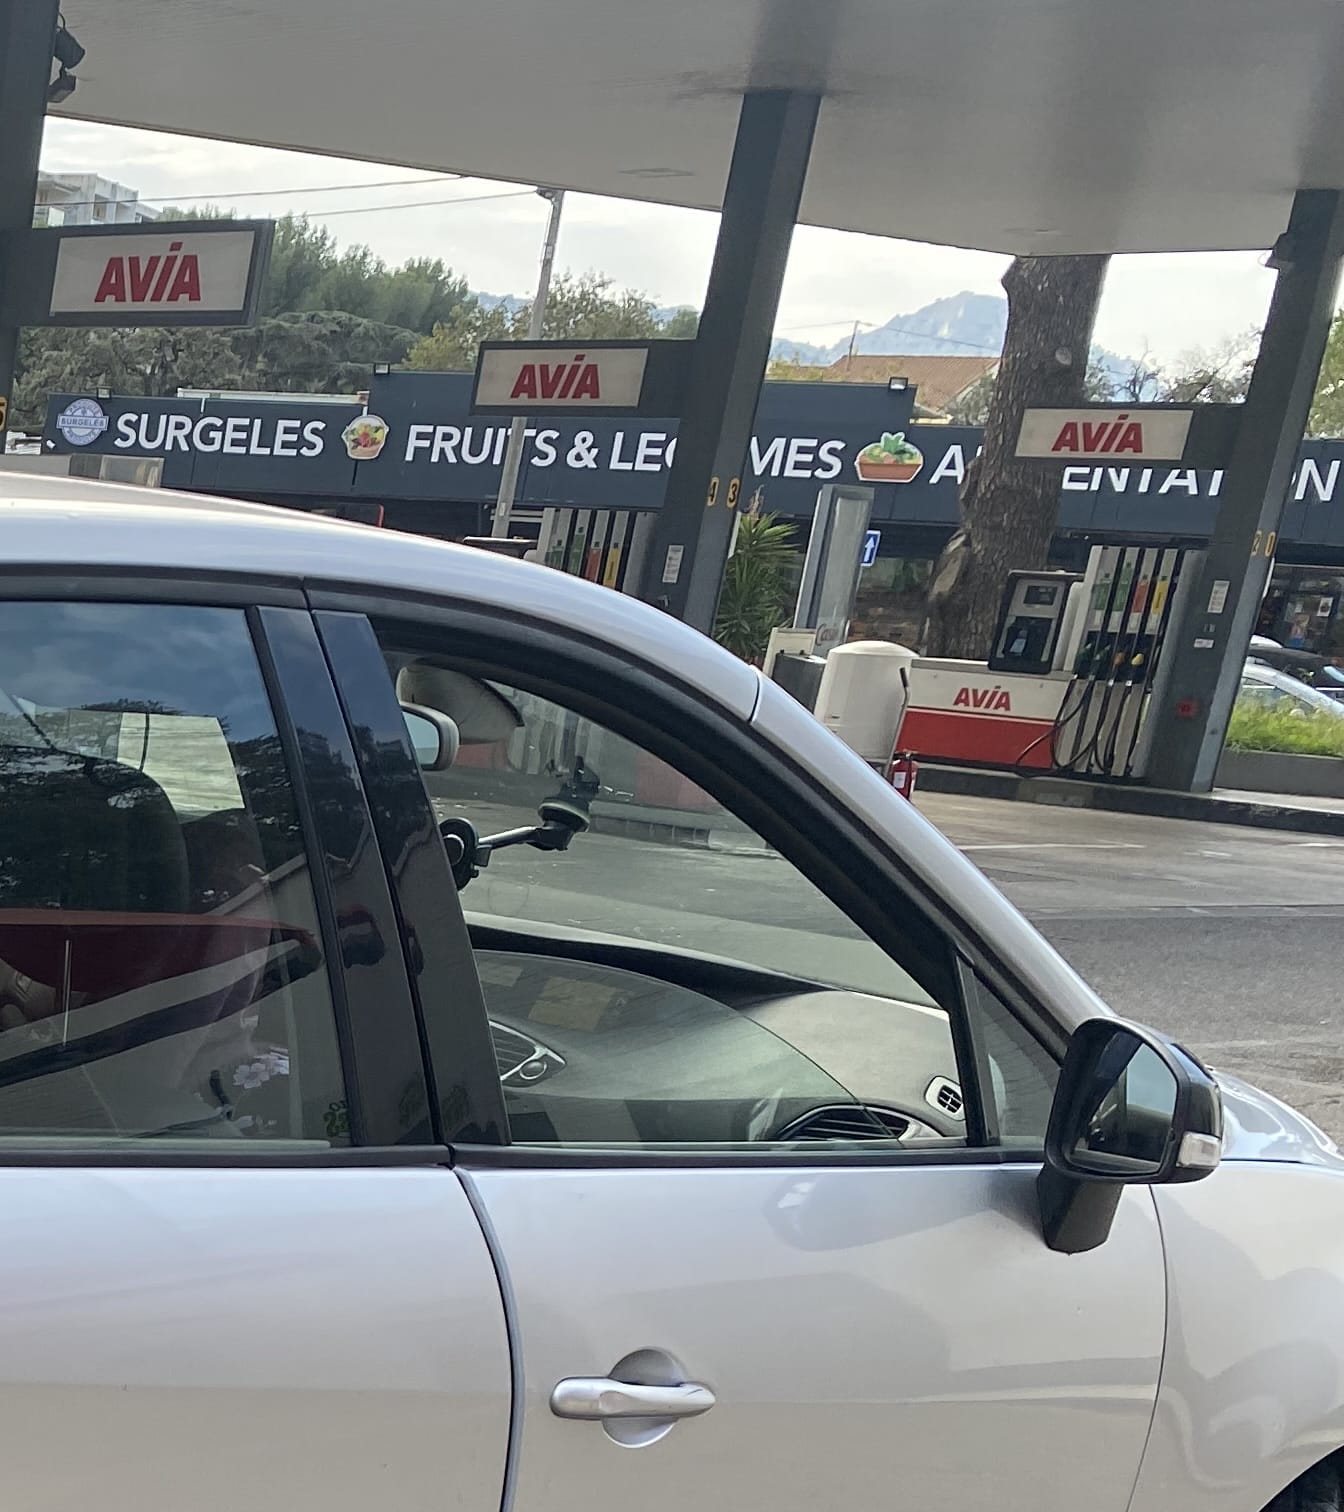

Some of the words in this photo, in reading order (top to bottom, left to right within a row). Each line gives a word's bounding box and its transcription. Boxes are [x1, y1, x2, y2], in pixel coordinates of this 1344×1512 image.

[113, 412, 327, 457] SURGELES
[566, 430, 599, 469] &
[728, 482, 738, 503] 3
